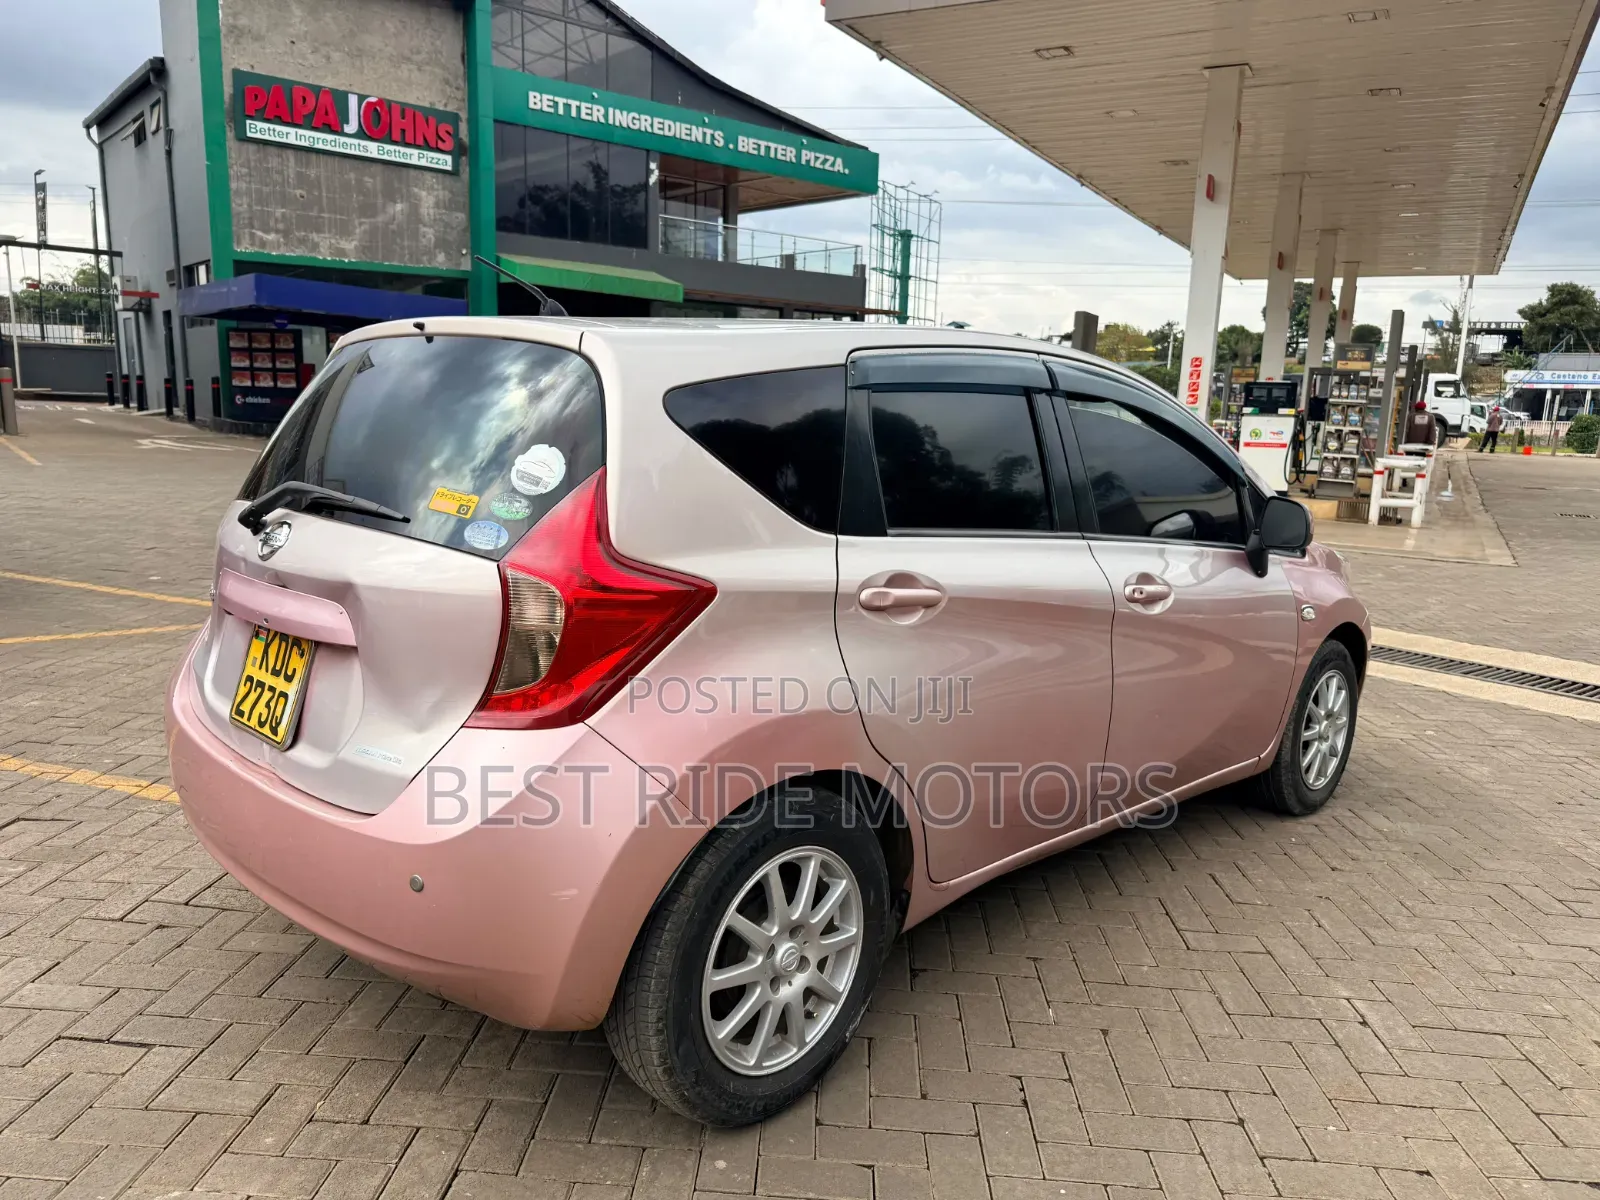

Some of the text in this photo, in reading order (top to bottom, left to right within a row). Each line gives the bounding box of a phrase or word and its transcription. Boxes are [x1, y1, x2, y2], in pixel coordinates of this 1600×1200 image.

[244, 84, 455, 151] PAPA JOHNS
[248, 122, 452, 168] Better Ingredients. Better Pizza.
[528, 90, 605, 123] BETTER
[738, 135, 797, 163] BETTER
[801, 149, 849, 175] PIZZA.
[40, 284, 60, 292] MAX
[259, 629, 304, 683] KDC
[234, 674, 289, 738] 273Q
